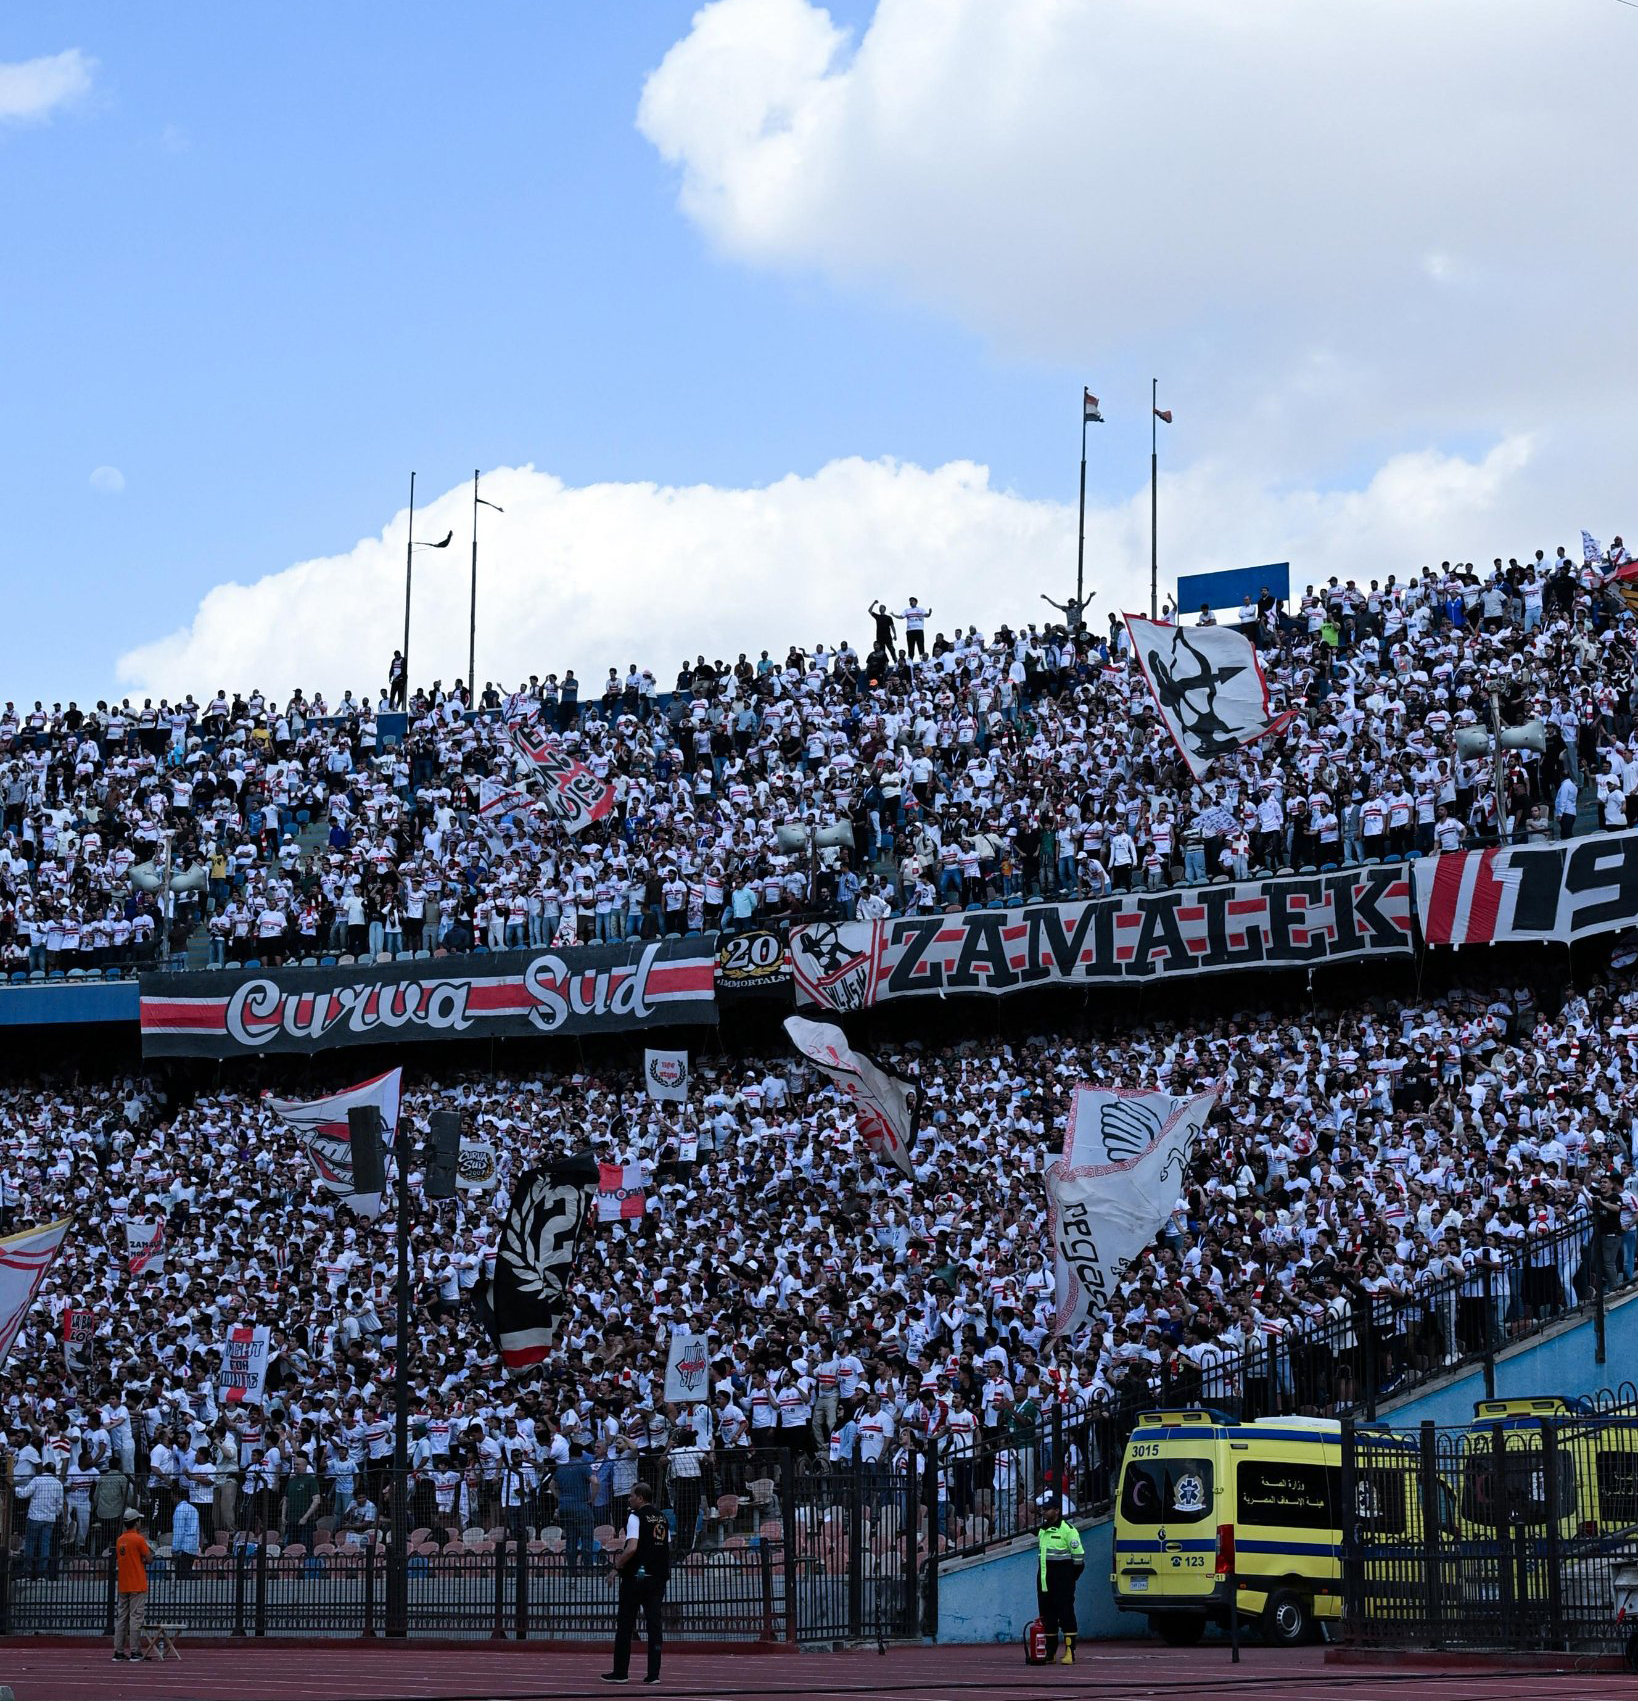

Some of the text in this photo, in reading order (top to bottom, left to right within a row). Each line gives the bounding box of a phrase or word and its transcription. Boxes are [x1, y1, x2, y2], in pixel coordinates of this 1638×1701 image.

[888, 866, 1412, 992] ZAMALEK
[726, 936, 779, 969] 20
[719, 975, 786, 989] IMMORTALS
[226, 943, 662, 1046] Curva Sud
[460, 1160, 487, 1172] SUD
[230, 1360, 249, 1371] FOR
[1131, 1444, 1159, 1458] 3015
[1261, 1476, 1304, 1490] وزارة الصحة
[1184, 1556, 1205, 1567] 123
